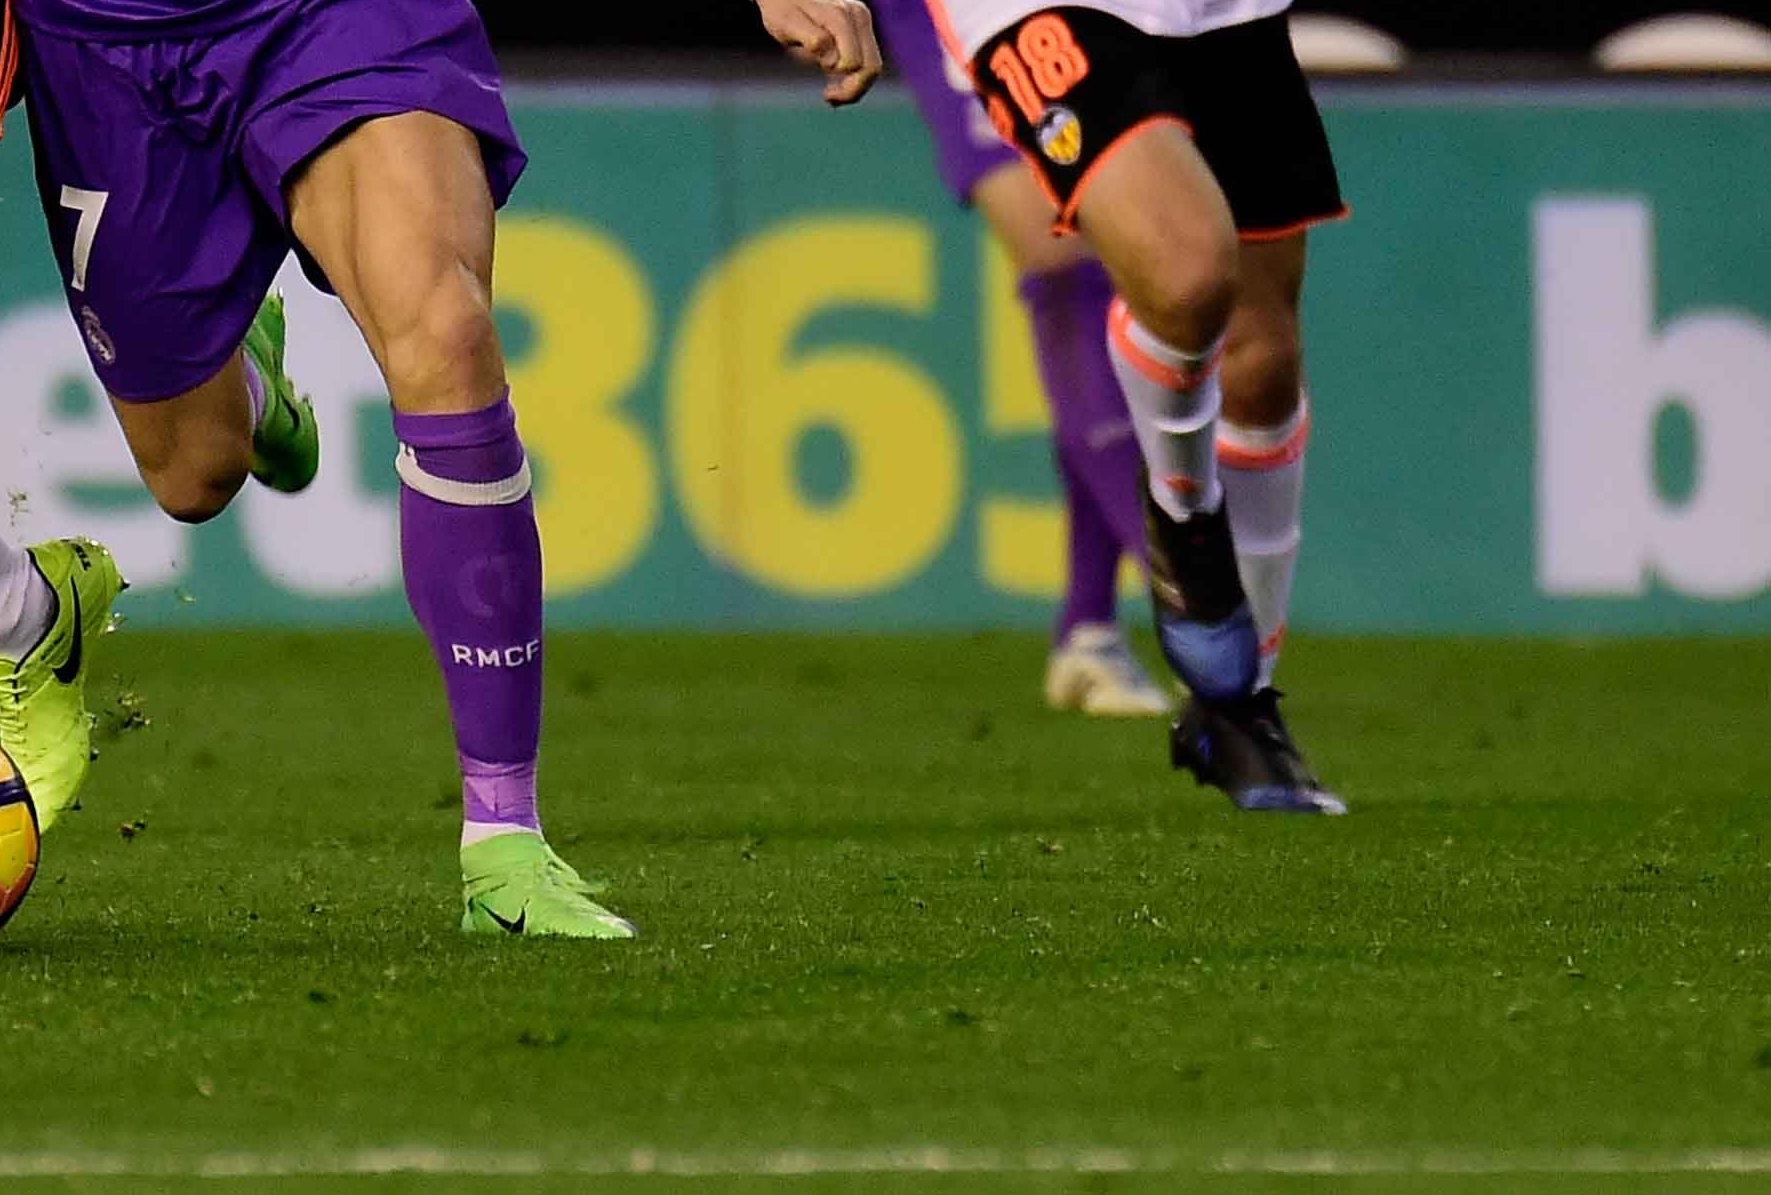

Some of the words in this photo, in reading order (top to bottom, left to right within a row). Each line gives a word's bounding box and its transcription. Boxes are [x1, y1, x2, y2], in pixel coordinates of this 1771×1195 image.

[989, 12, 1090, 126] 18
[60, 184, 109, 292] 7
[451, 638, 540, 668] RMCF
